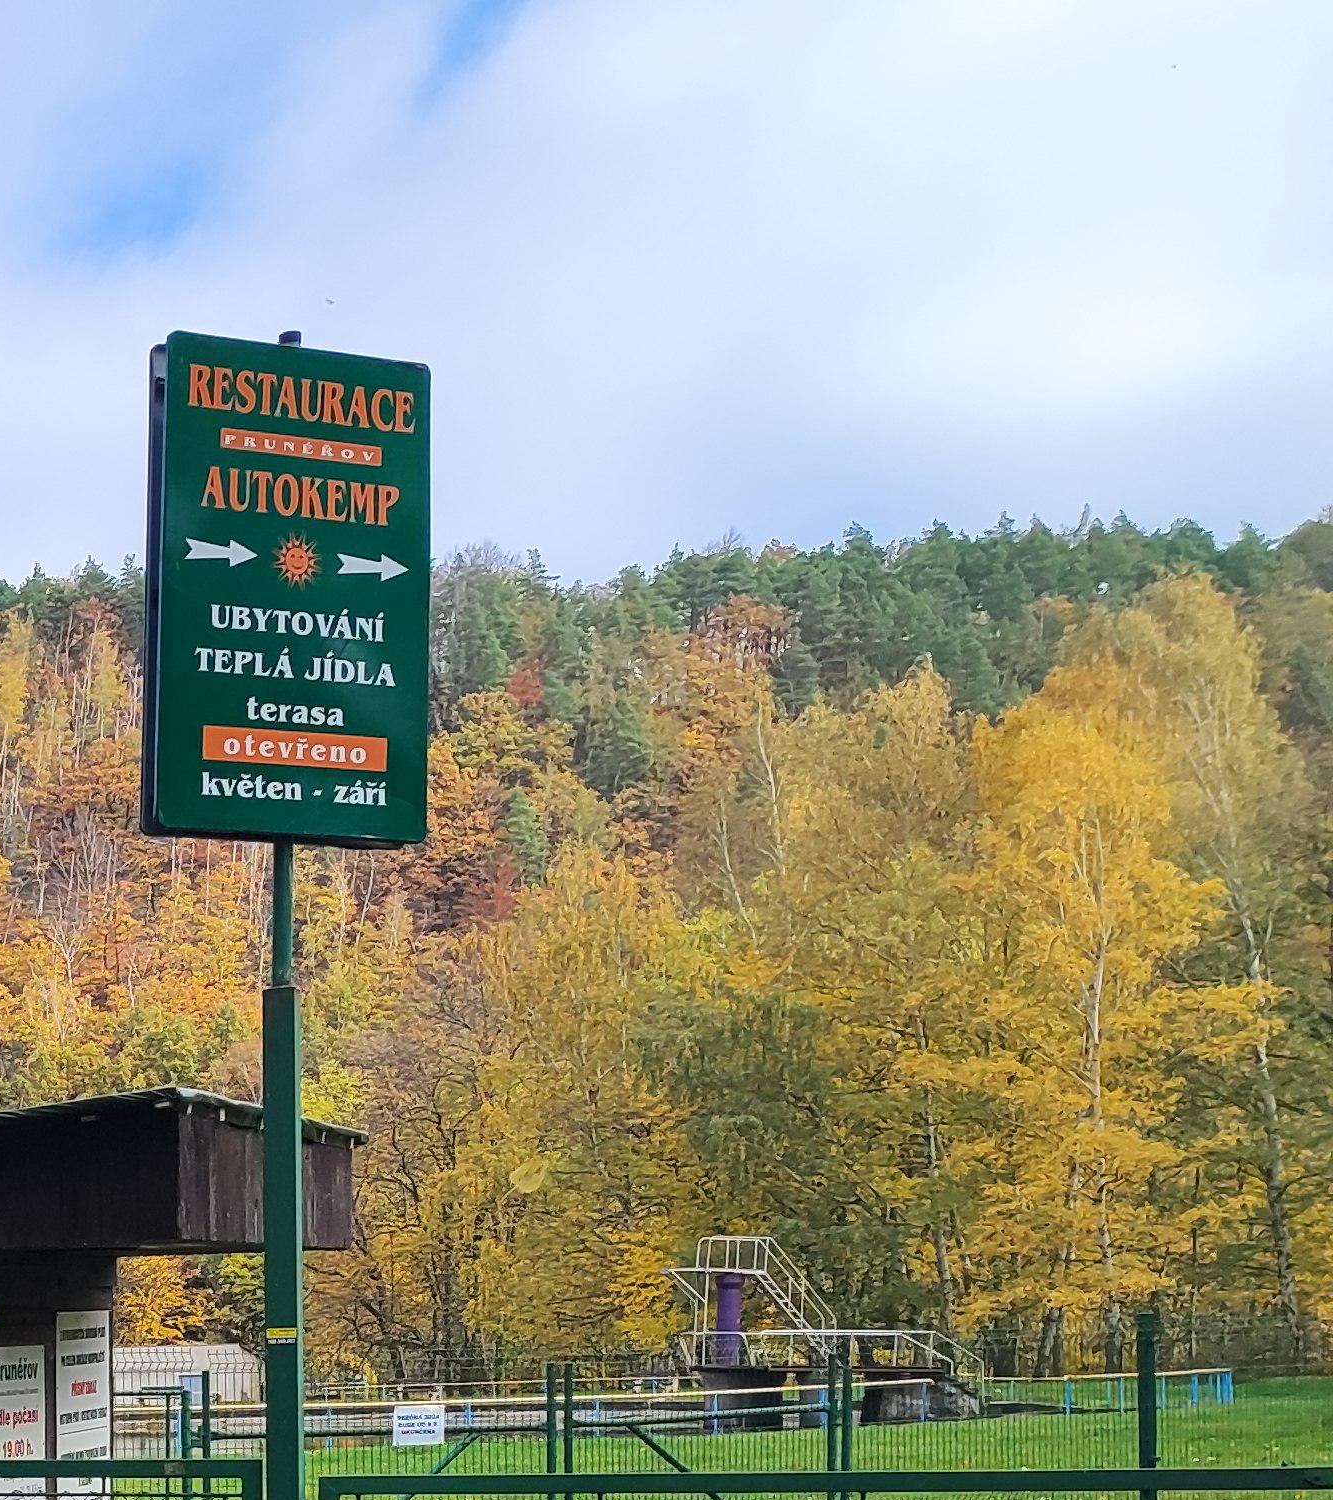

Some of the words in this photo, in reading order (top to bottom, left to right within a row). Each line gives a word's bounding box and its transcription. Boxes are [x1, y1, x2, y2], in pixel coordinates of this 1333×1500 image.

[188, 364, 416, 434] RESTAURACE
[201, 466, 399, 526] AUTOKEMP
[211, 604, 384, 642] UBYTOVÁNÍ
[194, 645, 294, 679] TEPLÁ
[304, 651, 396, 687] JÍDLA
[247, 696, 344, 726] terasa
[223, 733, 367, 764] otevřeno
[201, 772, 302, 801] květen
[333, 780, 387, 806] září
